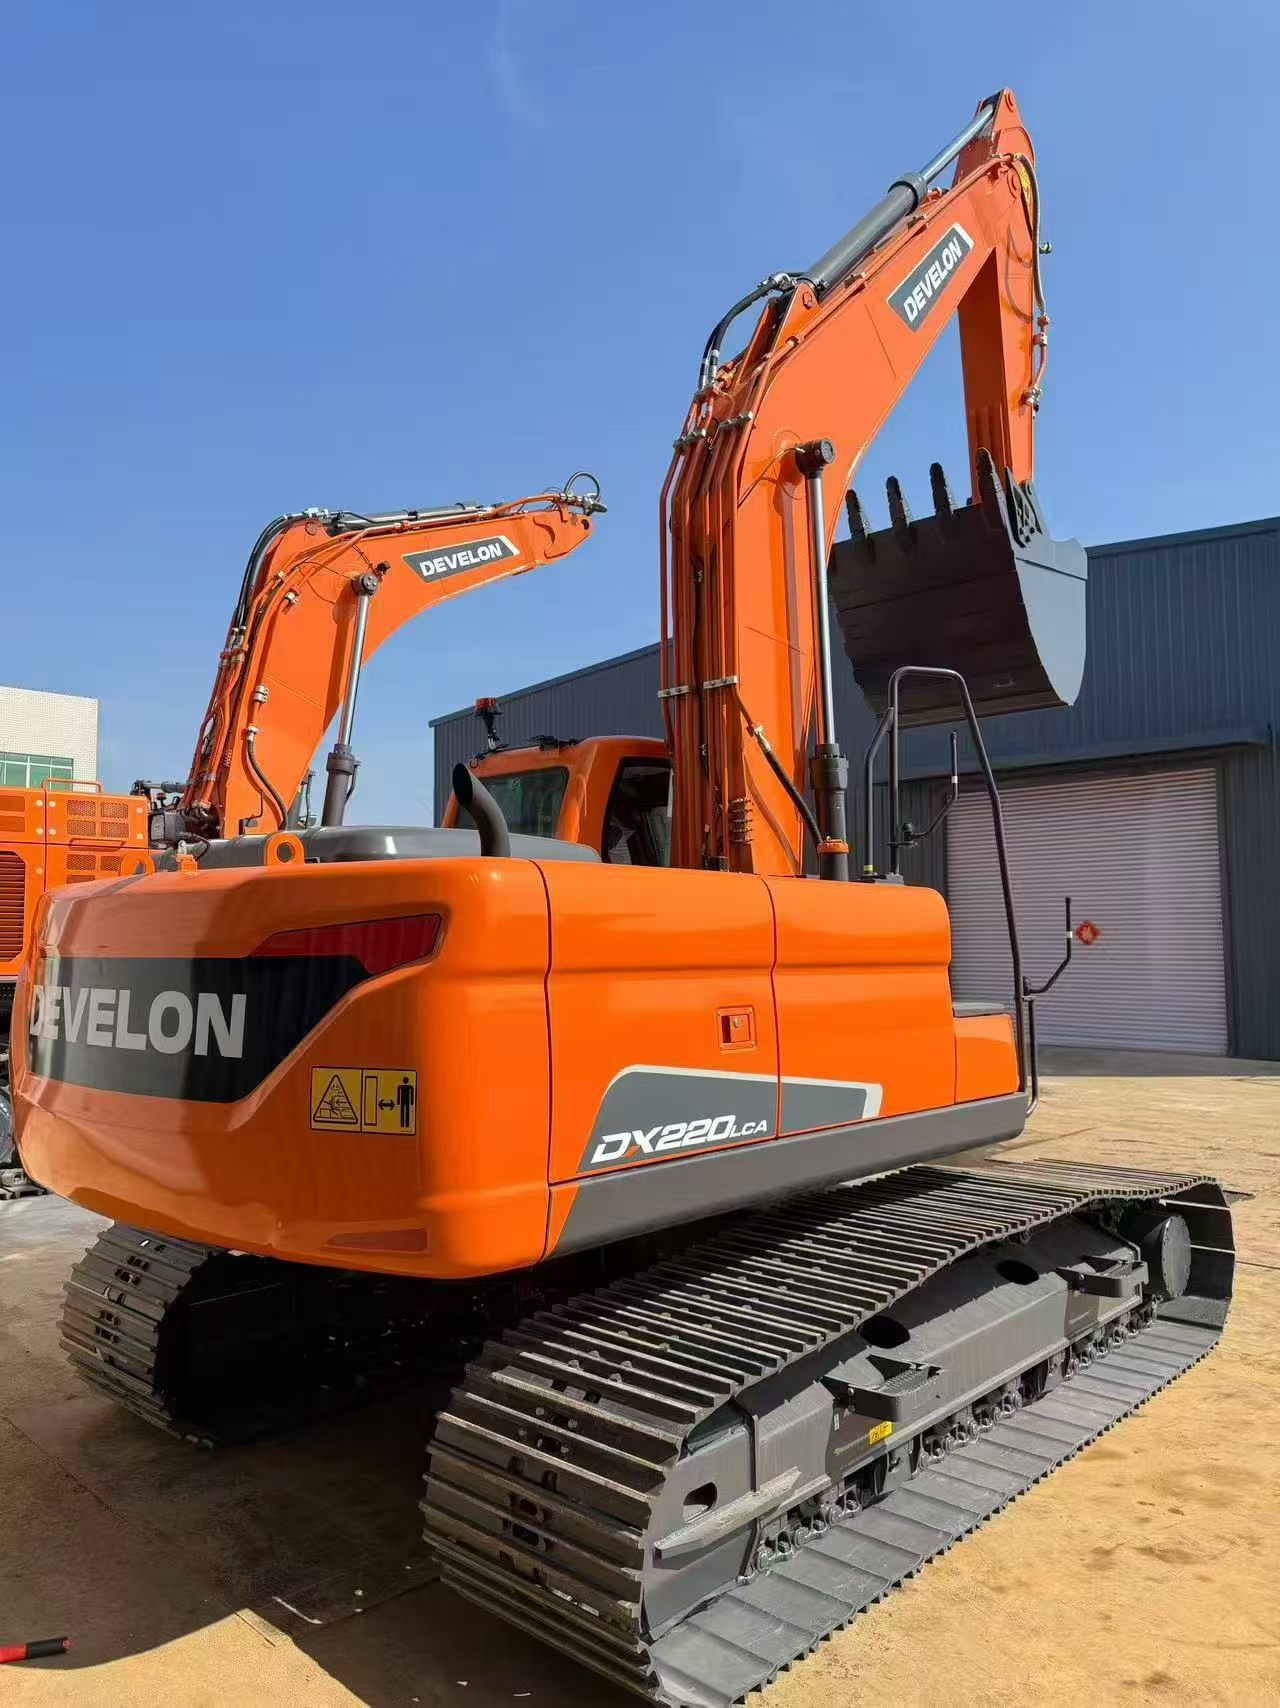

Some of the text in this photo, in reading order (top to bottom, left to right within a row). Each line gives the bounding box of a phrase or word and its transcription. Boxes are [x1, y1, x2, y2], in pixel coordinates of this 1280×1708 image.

[903, 236, 963, 323] DEVELON
[420, 542, 503, 577] DEVELON
[30, 984, 247, 1059] DEVELON
[590, 1114, 768, 1164] DX220LCA
